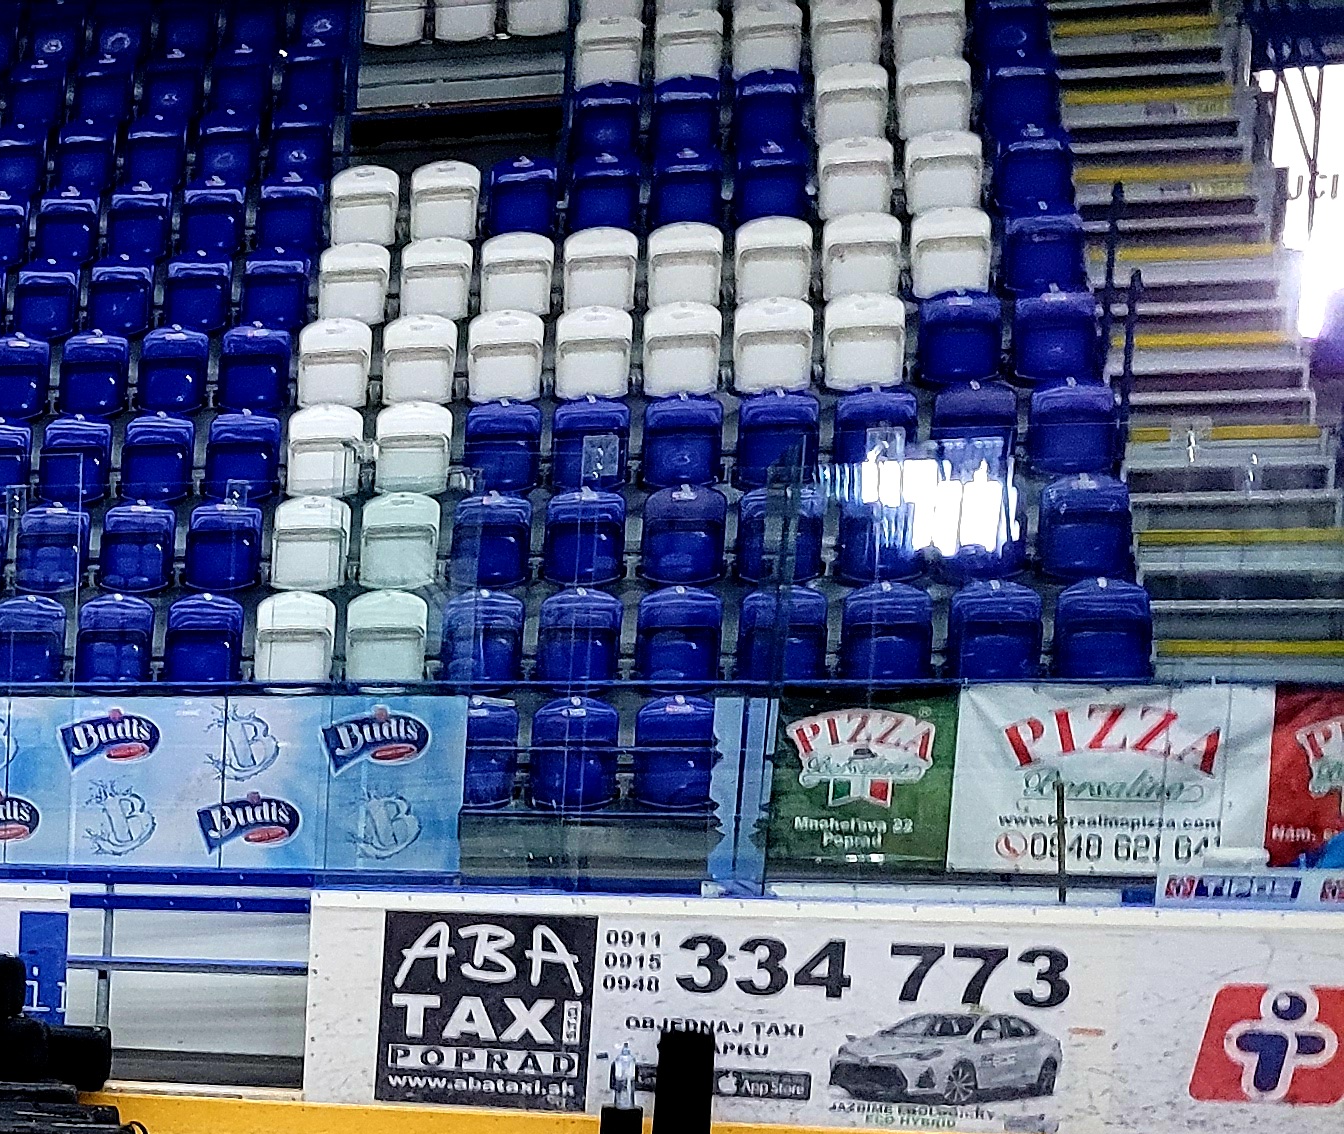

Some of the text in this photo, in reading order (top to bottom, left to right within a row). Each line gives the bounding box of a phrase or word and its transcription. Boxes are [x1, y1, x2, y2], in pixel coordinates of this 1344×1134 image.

[72, 716, 152, 756] Budiš
[334, 716, 419, 757] Budiš
[795, 715, 932, 763] PIZZA
[1004, 703, 1222, 778] PIZZA
[208, 801, 291, 840] Budiš
[605, 929, 662, 948] 0911
[393, 920, 584, 997] ABA
[603, 951, 662, 971] 0915
[675, 933, 1072, 1008] 334 773
[602, 974, 661, 993] 0948
[391, 992, 583, 1046] TAXI
[751, 1021, 805, 1039] TAXI
[389, 1047, 578, 1075] POPRAD
[387, 1073, 575, 1096] www.abataxi.sk
[741, 1078, 769, 1096] App
